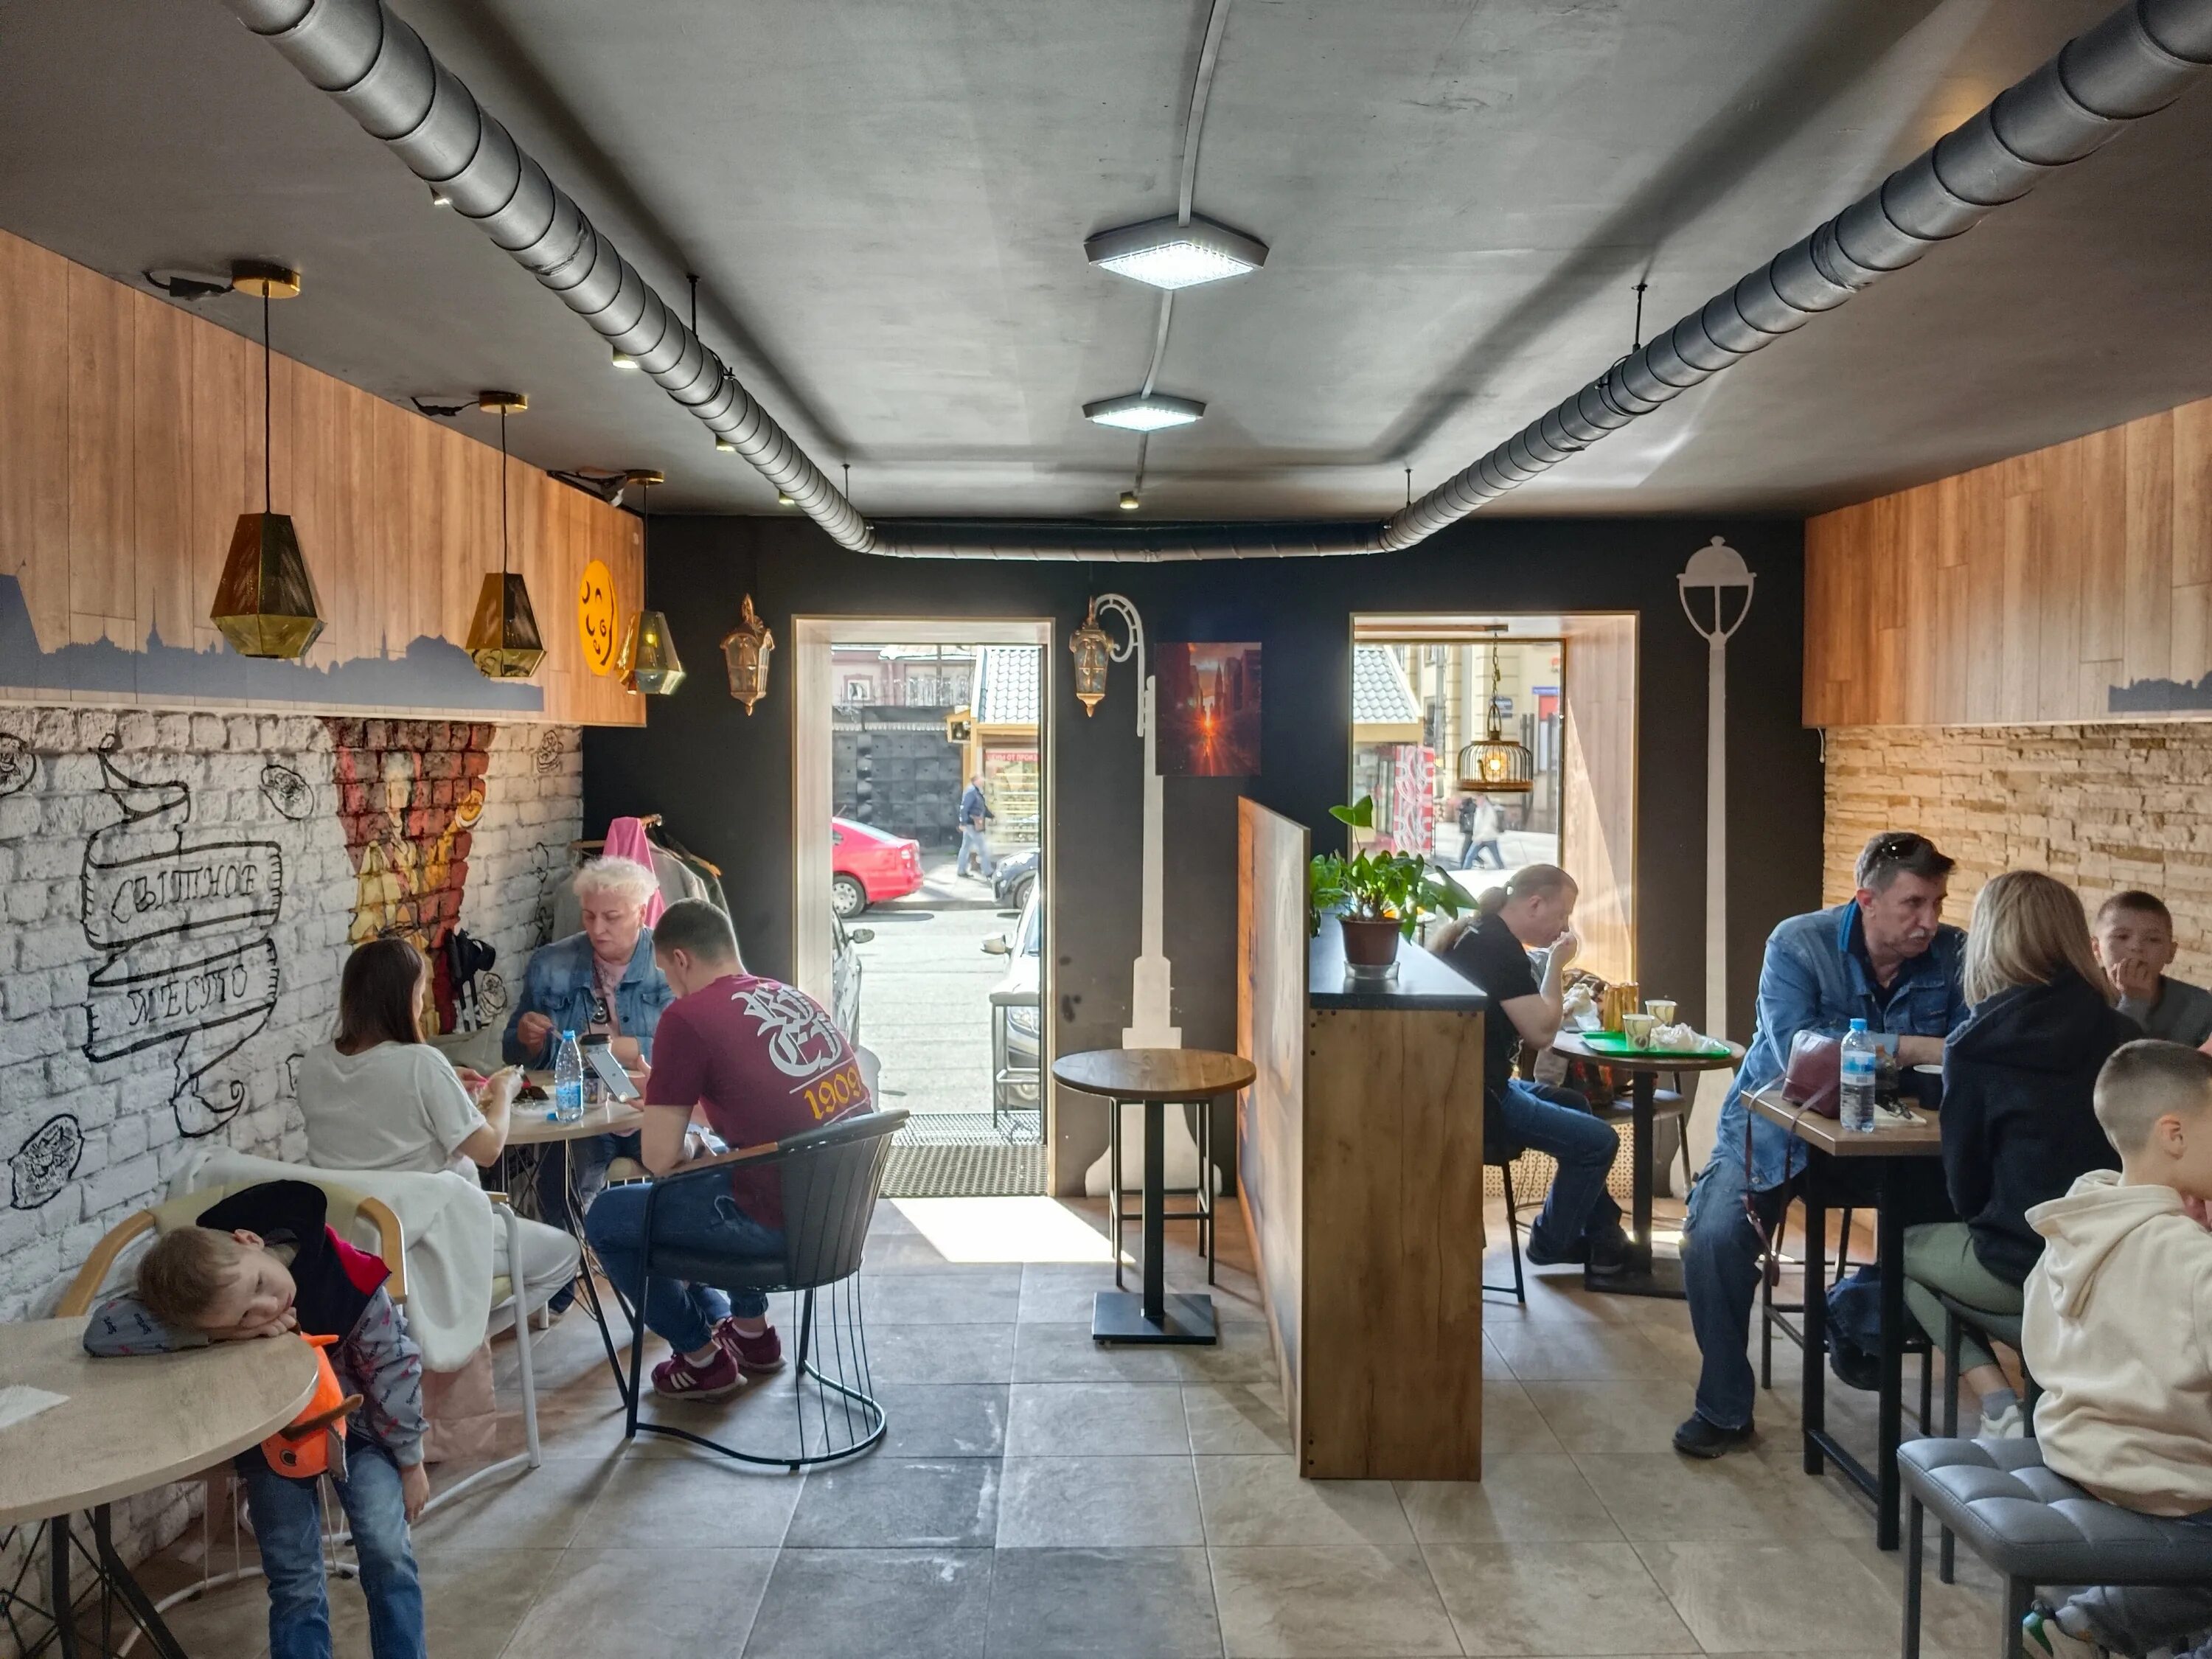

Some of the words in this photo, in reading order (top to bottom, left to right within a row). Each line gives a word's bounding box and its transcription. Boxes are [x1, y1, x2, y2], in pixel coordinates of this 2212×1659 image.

[1006, 754, 1015, 762] ОТ
[111, 865, 257, 923] СЫТНОЕ
[128, 964, 248, 1026] МЕСТО
[804, 1067, 861, 1119] 1909
